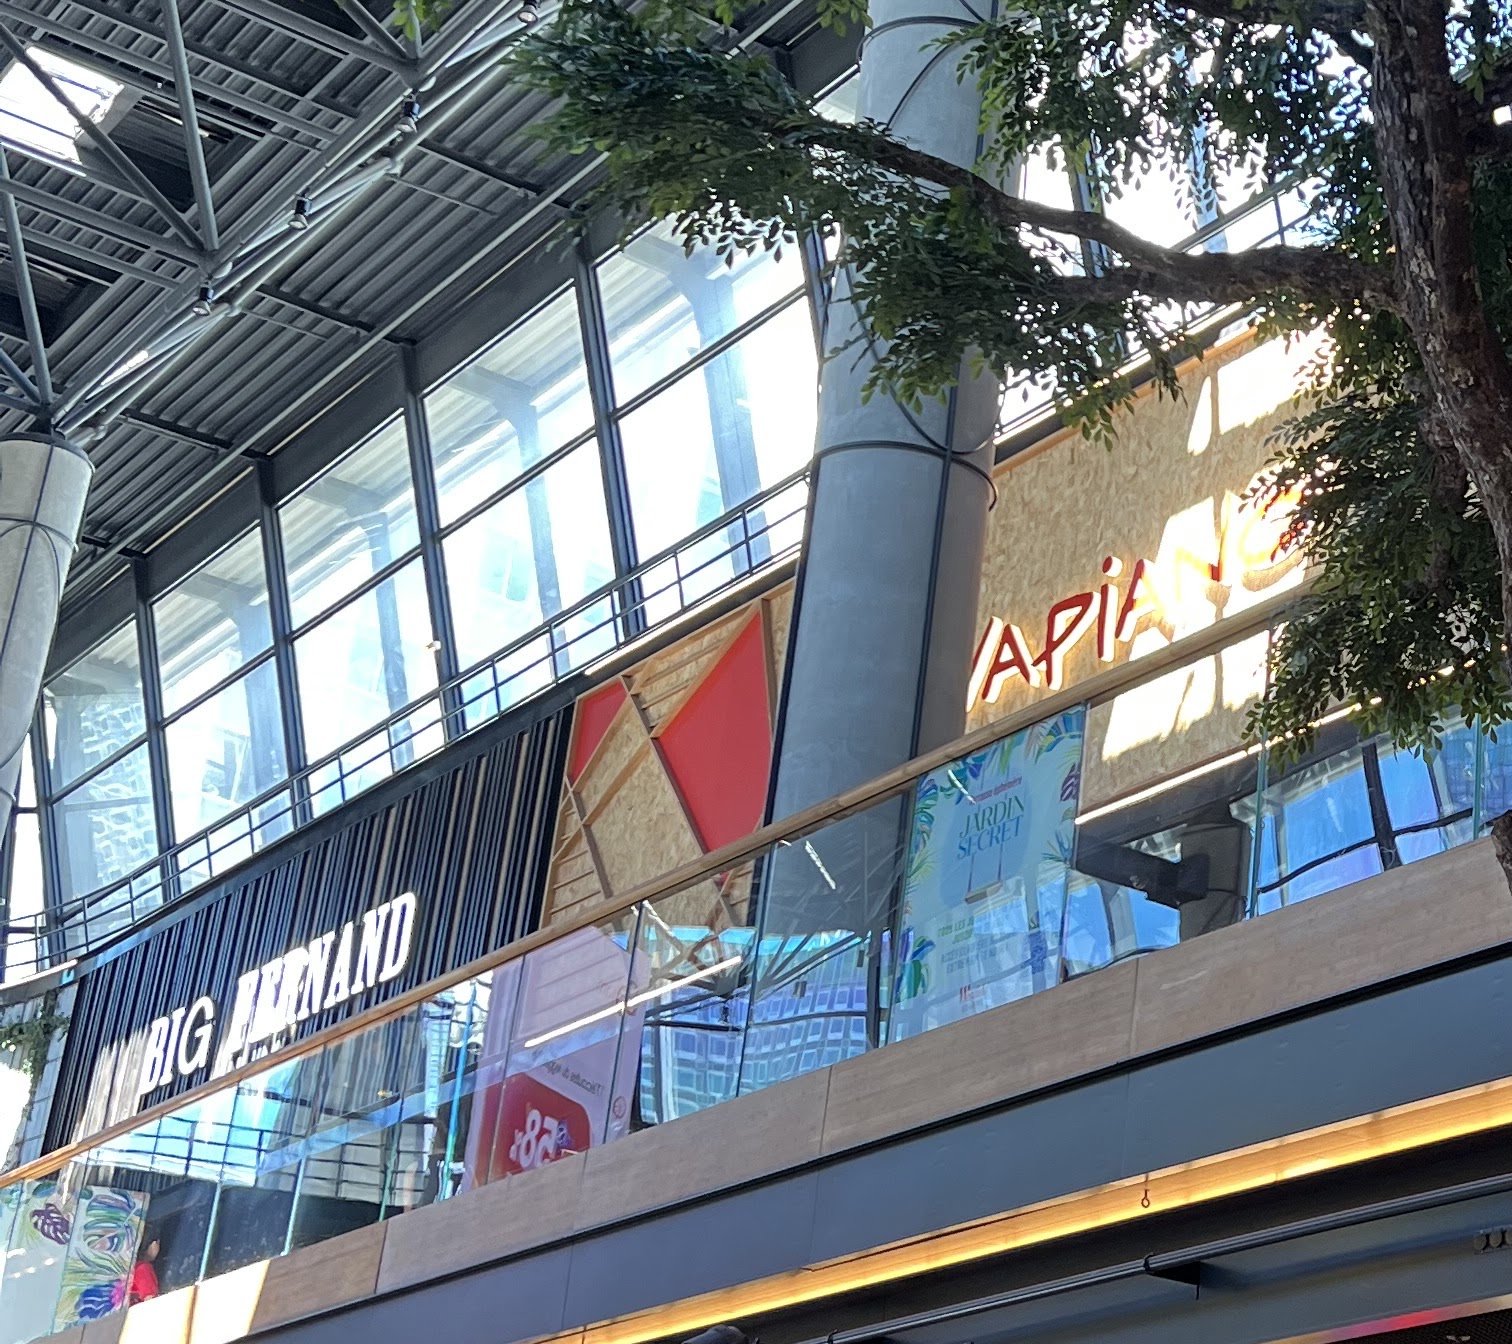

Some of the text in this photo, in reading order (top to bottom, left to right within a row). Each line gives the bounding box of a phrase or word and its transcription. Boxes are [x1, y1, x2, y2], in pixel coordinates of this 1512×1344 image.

[957, 814, 1024, 859] SECRET
[959, 795, 1025, 839] JARDIN
[138, 995, 215, 1095] BIG
